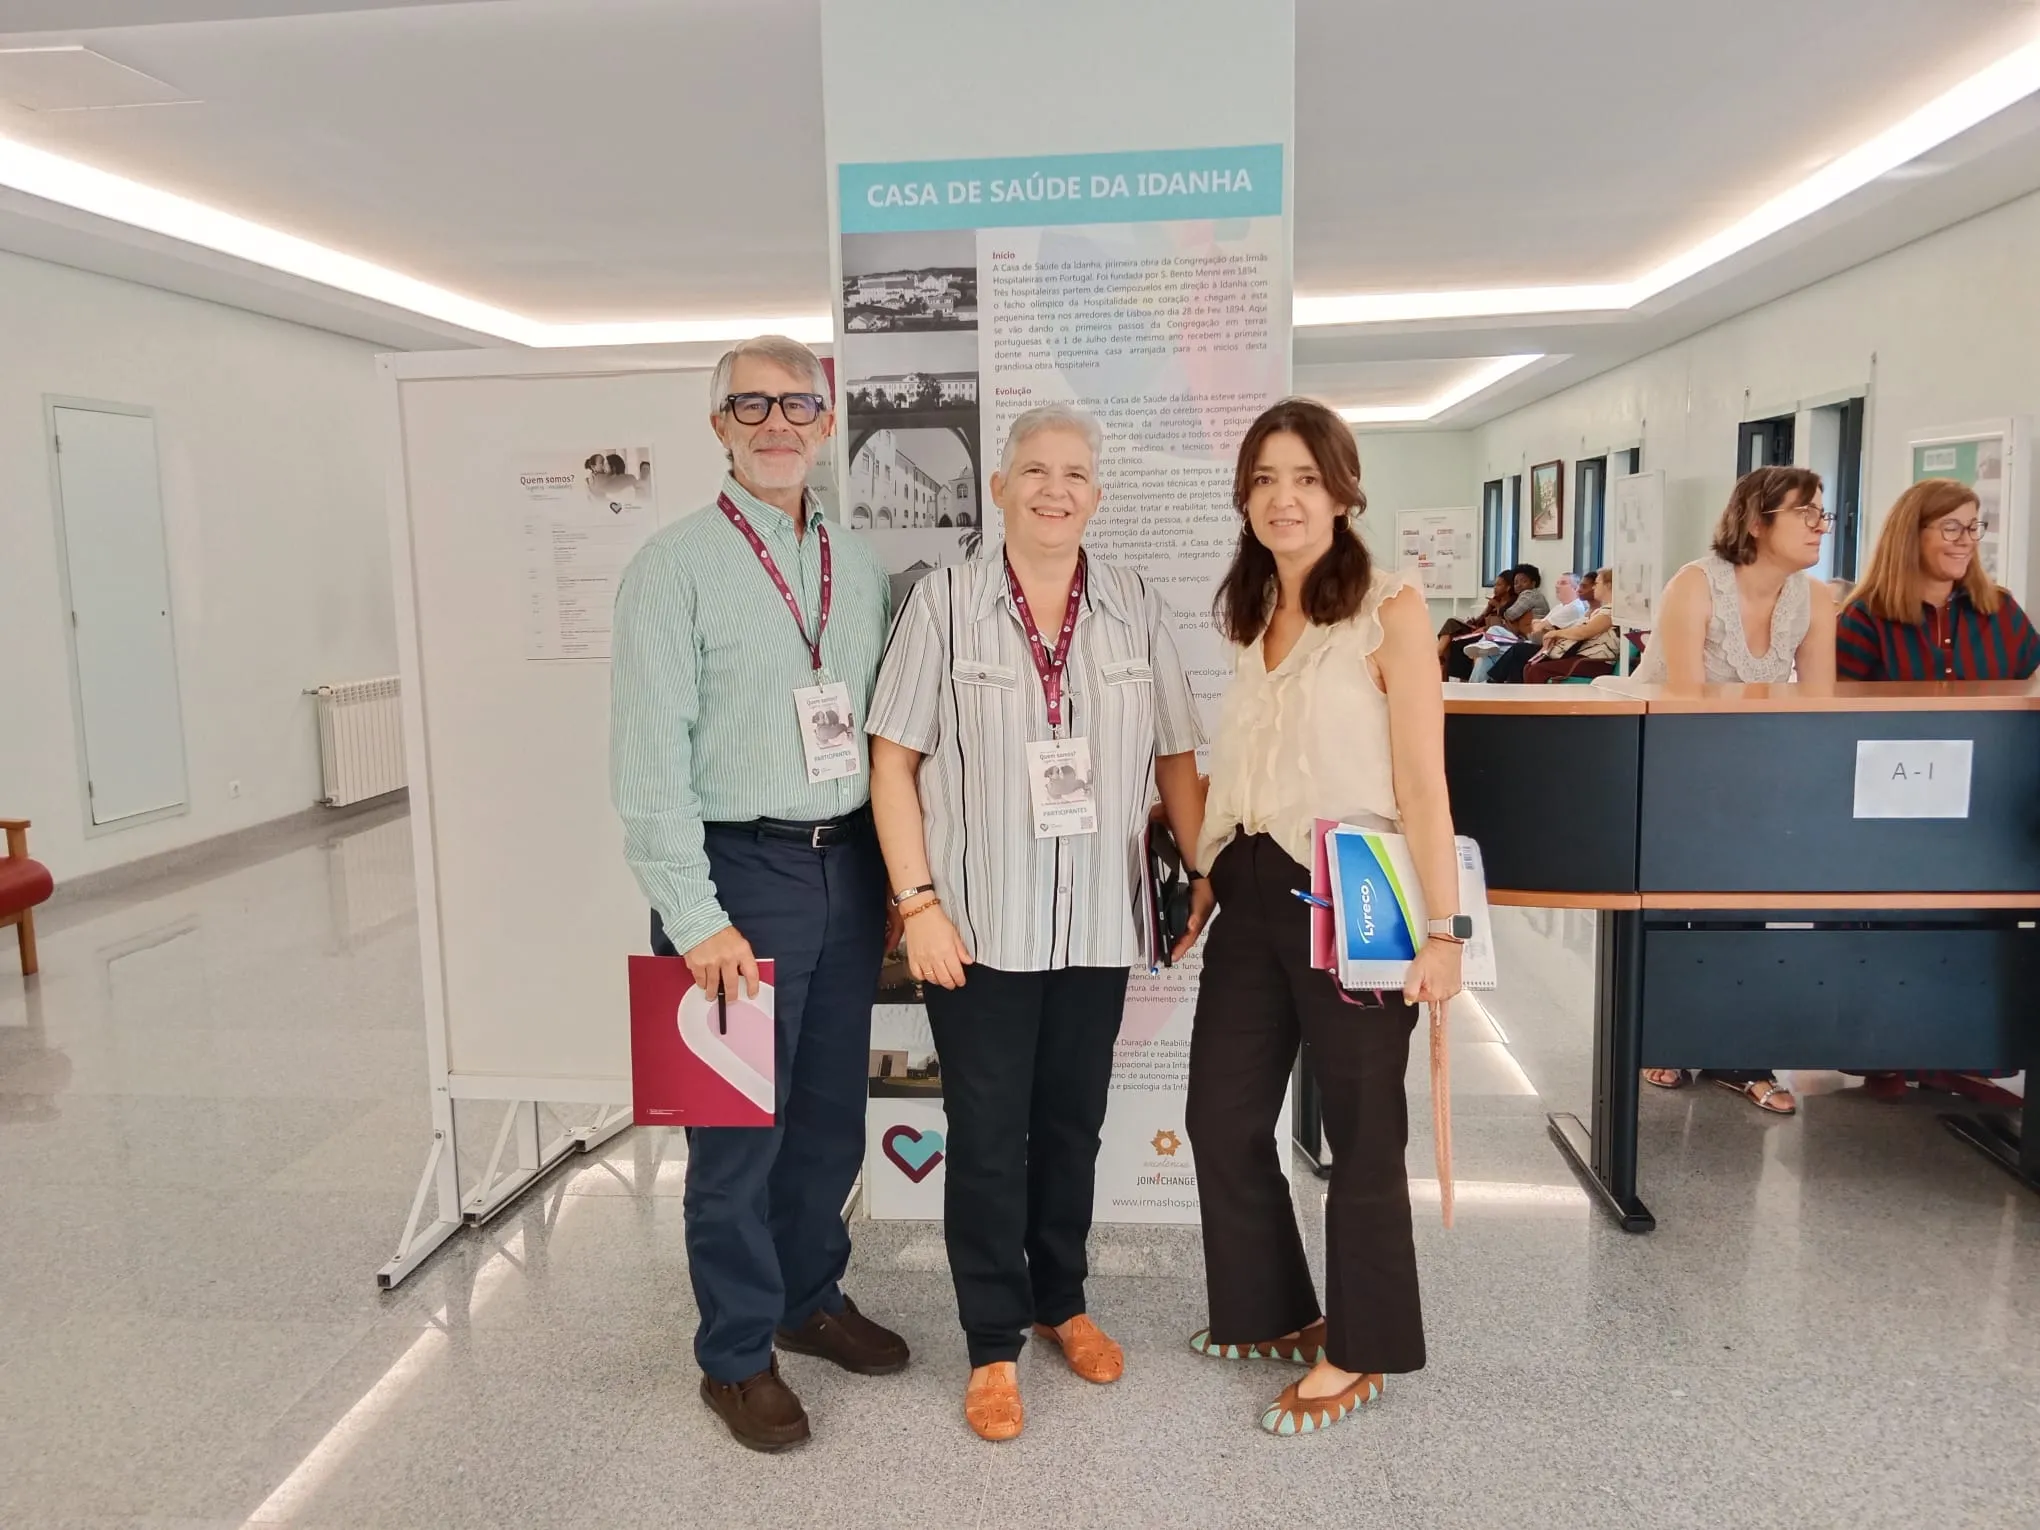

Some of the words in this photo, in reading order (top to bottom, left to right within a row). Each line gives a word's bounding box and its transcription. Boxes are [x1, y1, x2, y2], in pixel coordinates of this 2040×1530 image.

[867, 182, 940, 208] CASA
[947, 179, 983, 205] DE
[990, 171, 1082, 204] SAÚDE
[1090, 174, 1130, 199] DA
[1137, 168, 1254, 197] IDANHA
[992, 251, 1016, 260] Início
[995, 387, 1032, 396] Evolução
[520, 476, 544, 485] Quem
[545, 474, 575, 484] somos?
[1360, 885, 1375, 936] Lyreco
[1112, 1198, 1200, 1209] www.irmashospit
